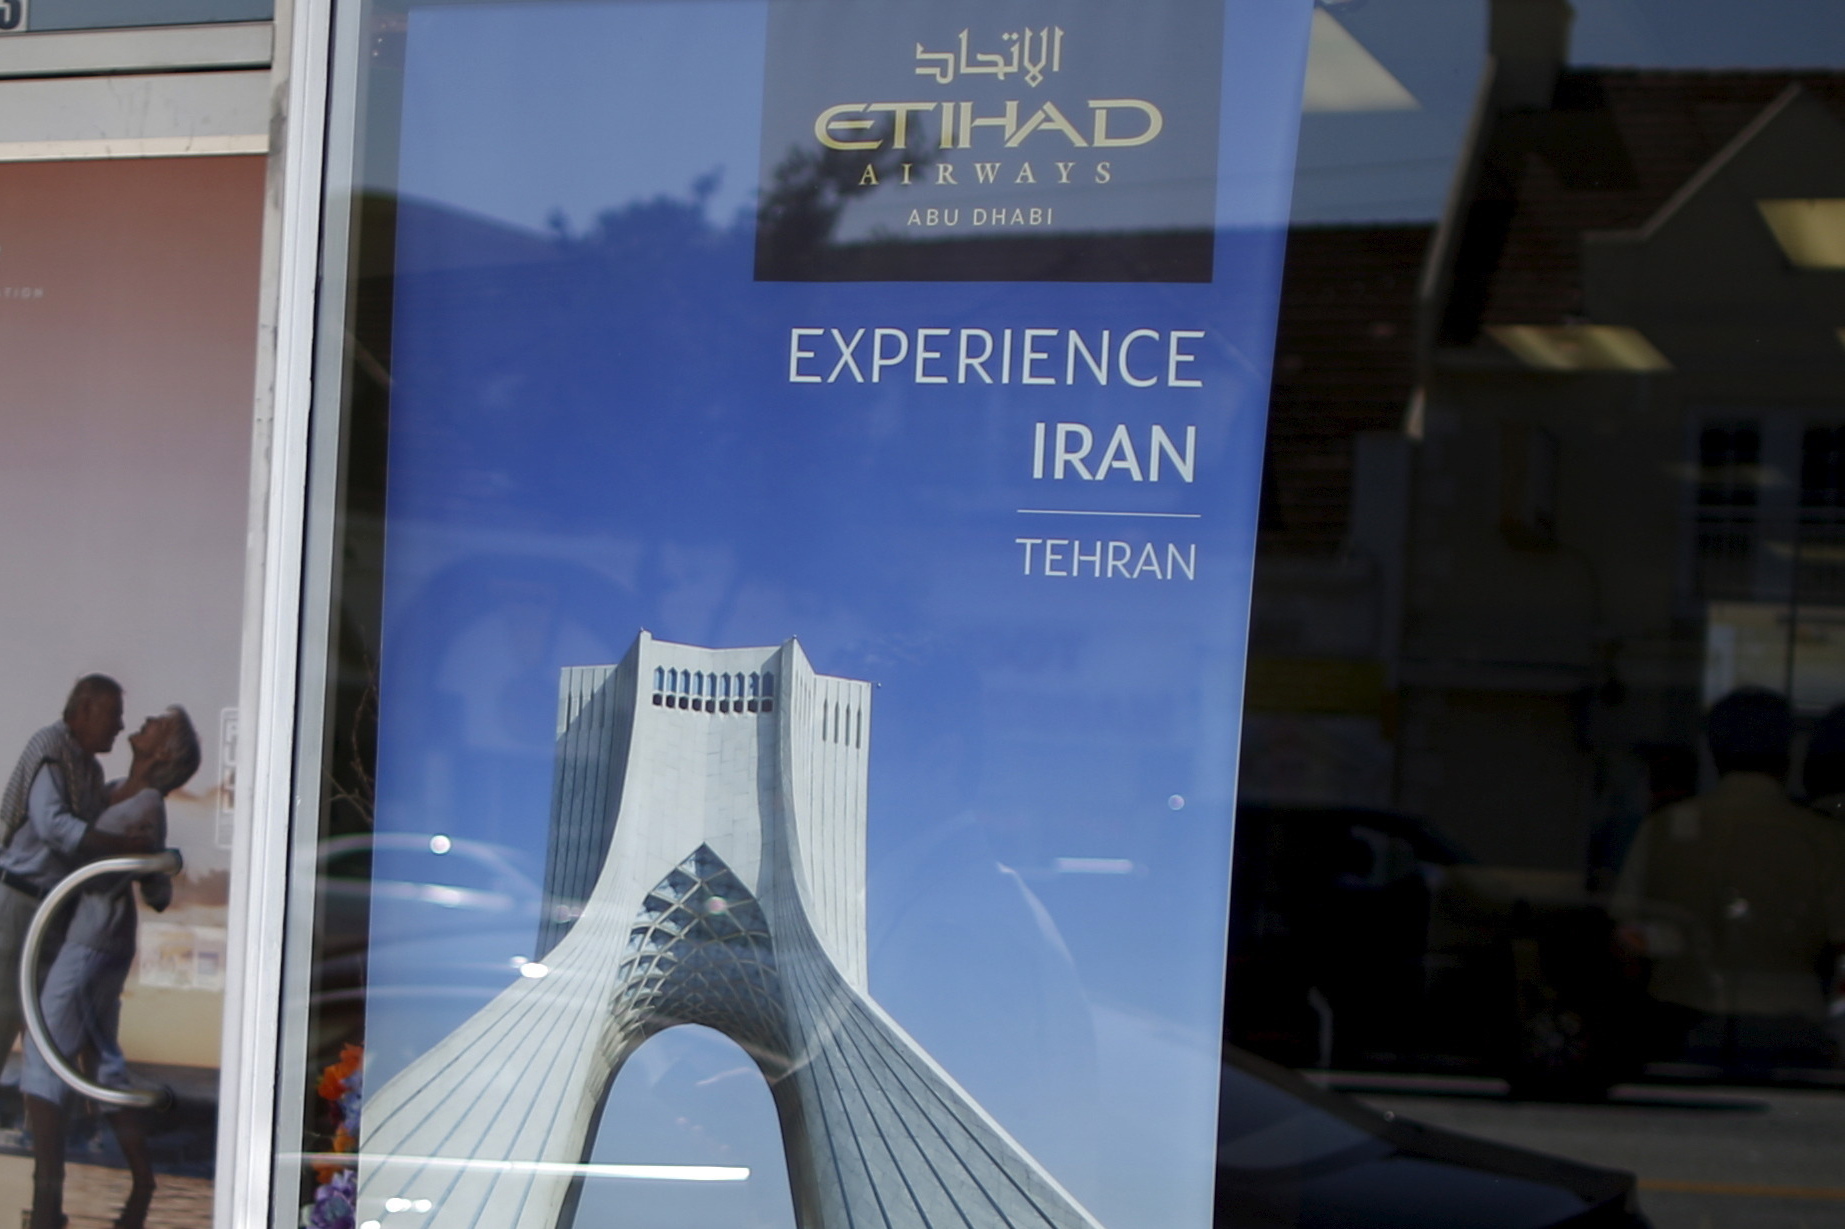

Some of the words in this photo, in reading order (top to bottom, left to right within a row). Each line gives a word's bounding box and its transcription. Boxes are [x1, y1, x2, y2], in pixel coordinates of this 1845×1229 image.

[814, 98, 1164, 150] ETIHAD
[858, 161, 1112, 186] AIRWAYS
[907, 208, 960, 226] ABU
[972, 207, 1054, 226] DHABI
[788, 327, 1206, 388] EXPERIENCE
[1032, 422, 1197, 483] IRAN
[1015, 538, 1197, 581] TEHRAN
